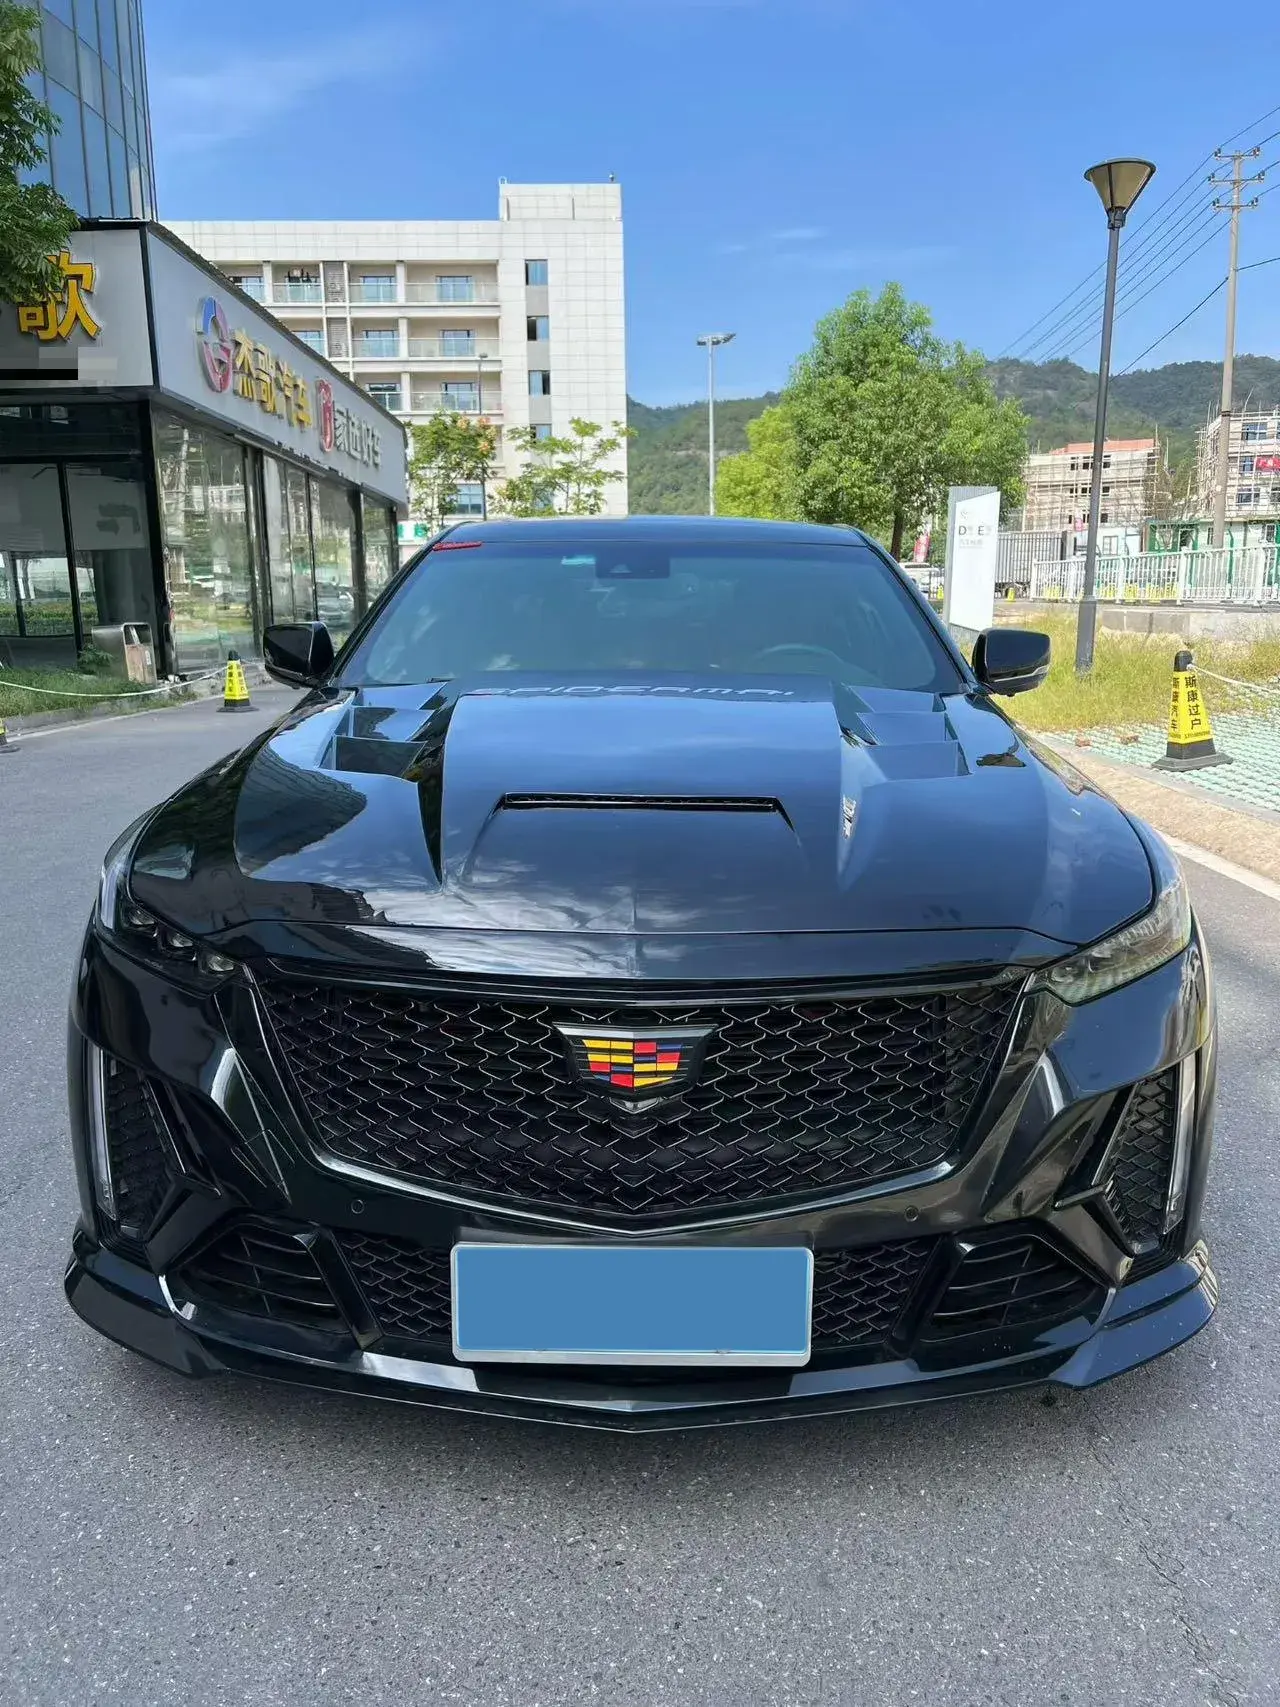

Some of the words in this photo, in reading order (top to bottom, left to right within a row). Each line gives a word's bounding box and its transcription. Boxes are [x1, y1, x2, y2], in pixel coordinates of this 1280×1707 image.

[232, 328, 313, 430] 杰歌汽车
[1184, 675, 1202, 730] 斯康过户
